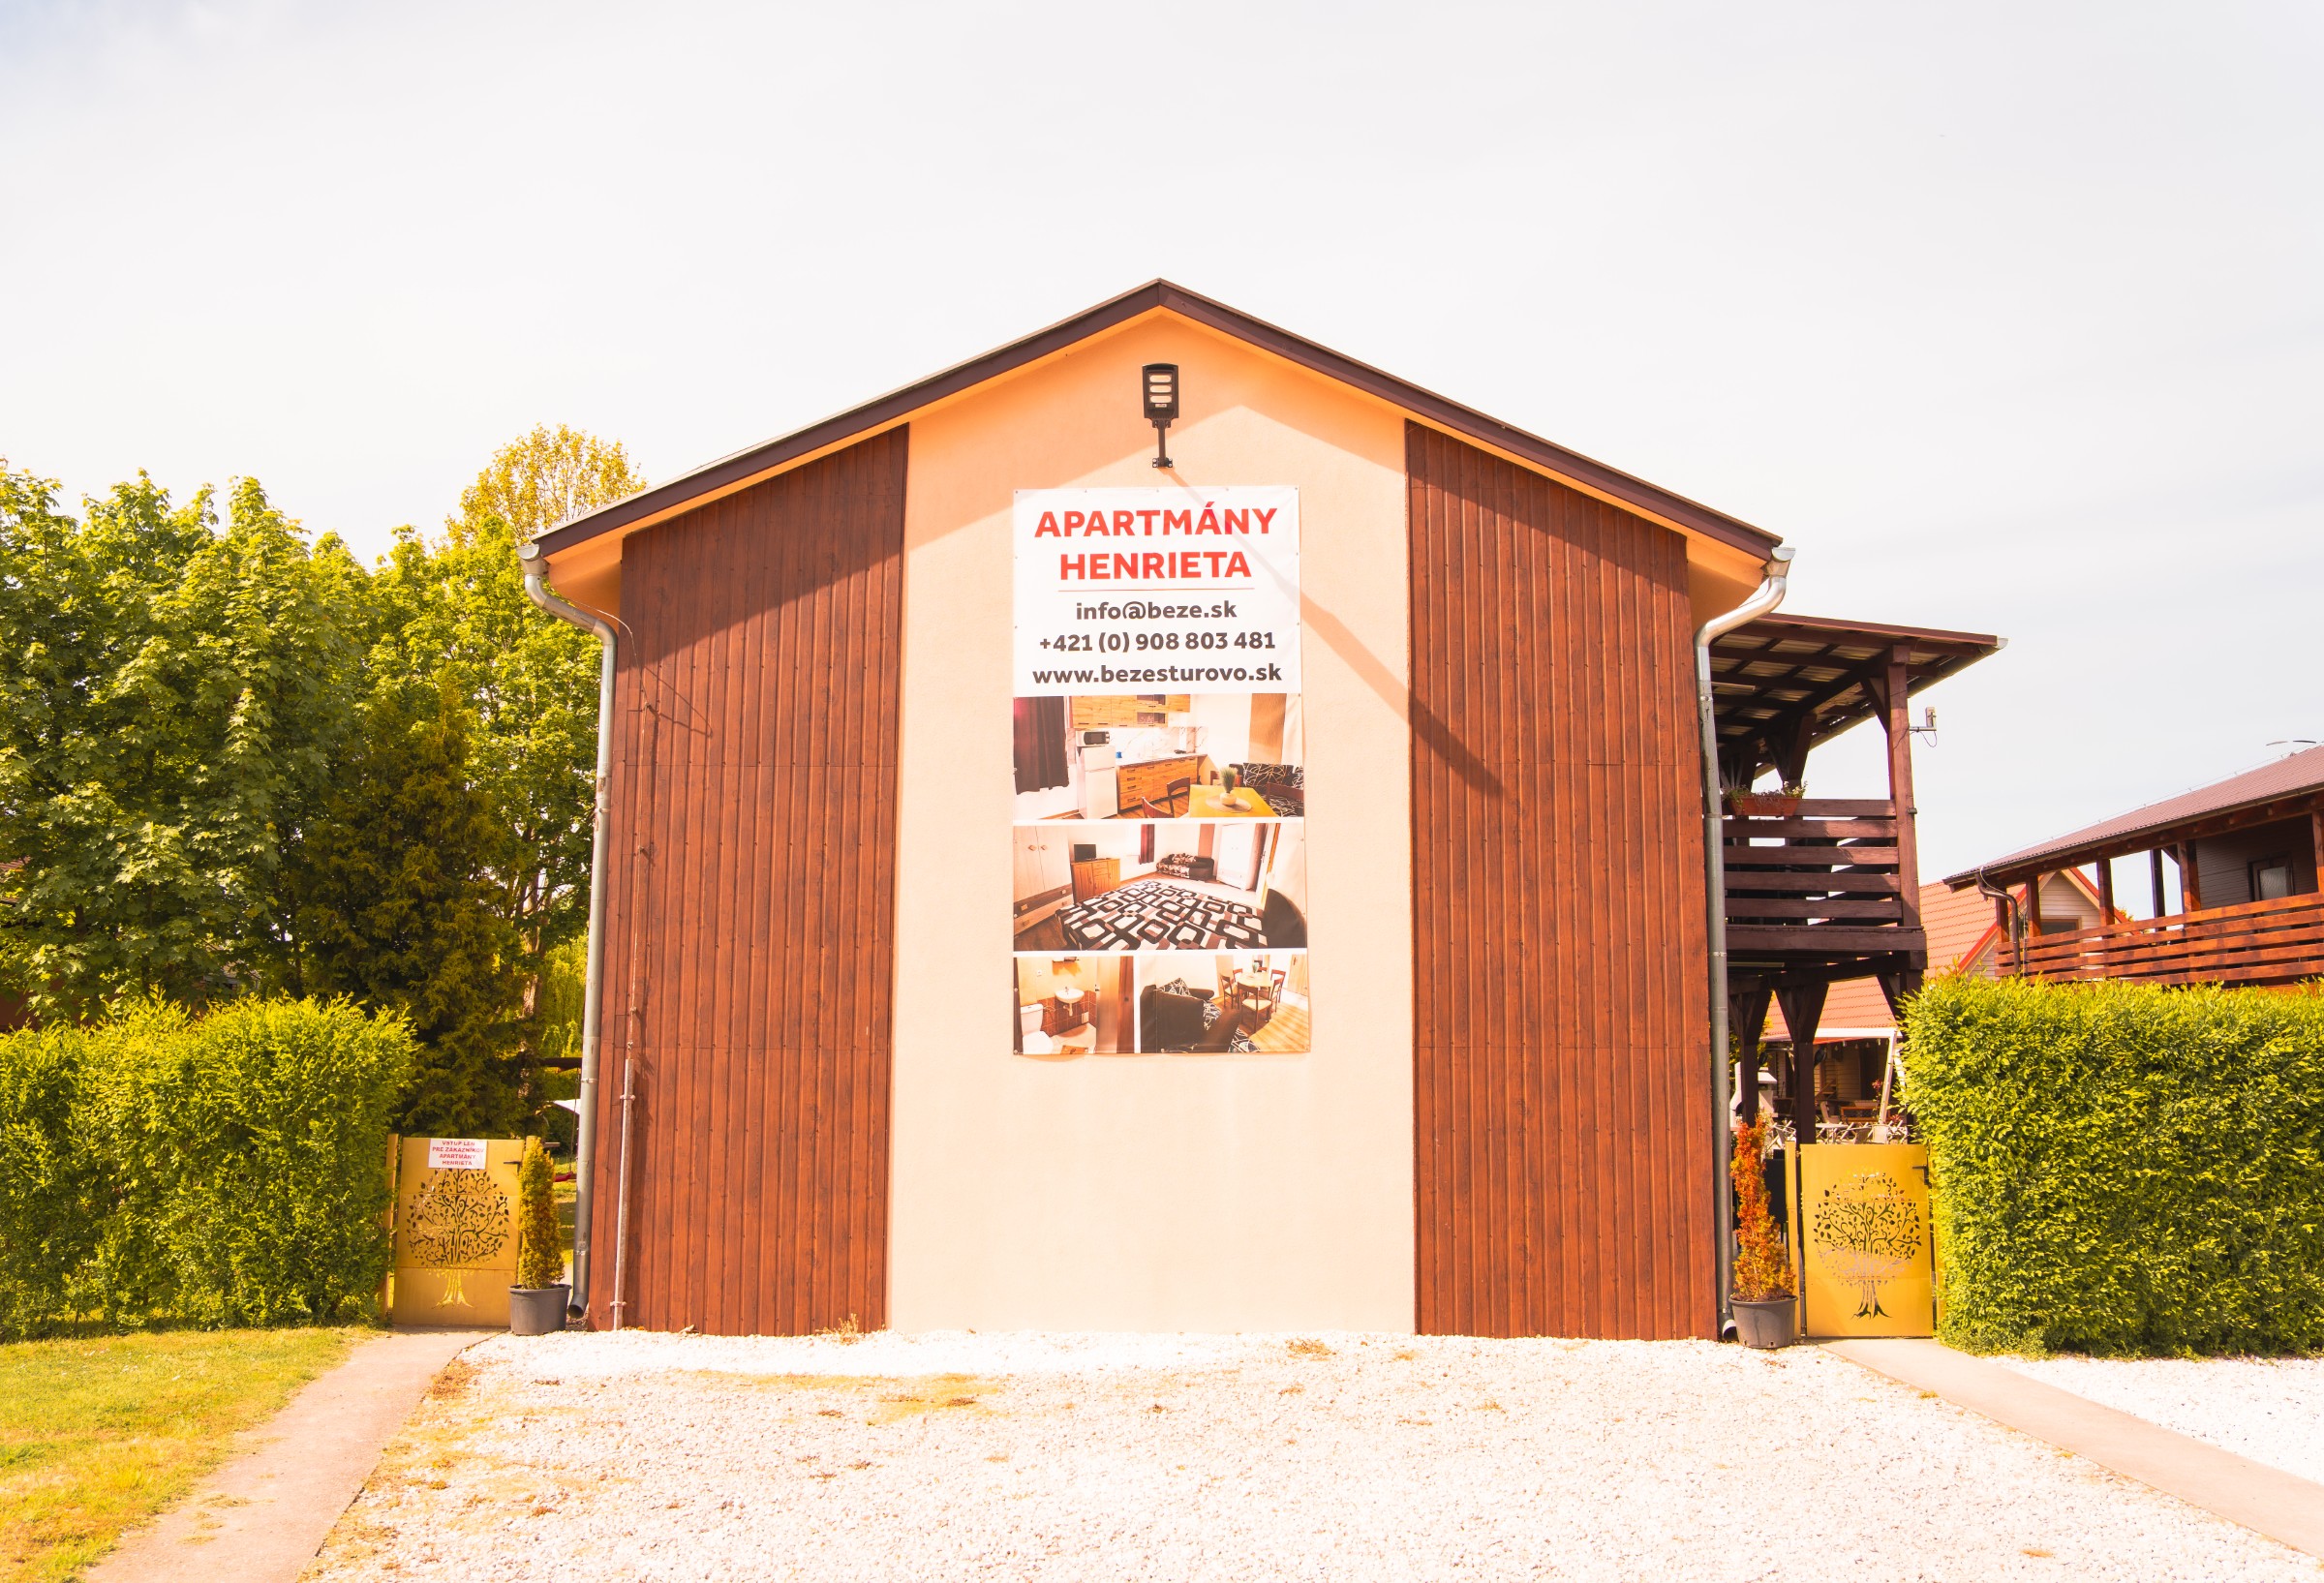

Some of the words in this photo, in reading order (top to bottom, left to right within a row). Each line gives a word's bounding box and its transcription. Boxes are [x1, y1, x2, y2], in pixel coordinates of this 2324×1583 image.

[1034, 501, 1278, 537] APARTMÁNY
[1059, 551, 1252, 581] HENRIETA
[1076, 599, 1238, 621] info@beze.sk
[1039, 633, 1093, 653] +421
[1098, 632, 1130, 654] (0)
[1135, 632, 1179, 652] 908
[1184, 631, 1229, 651] 803
[1234, 631, 1276, 650] 481
[1032, 662, 1282, 684] www.bezesturovo.sk
